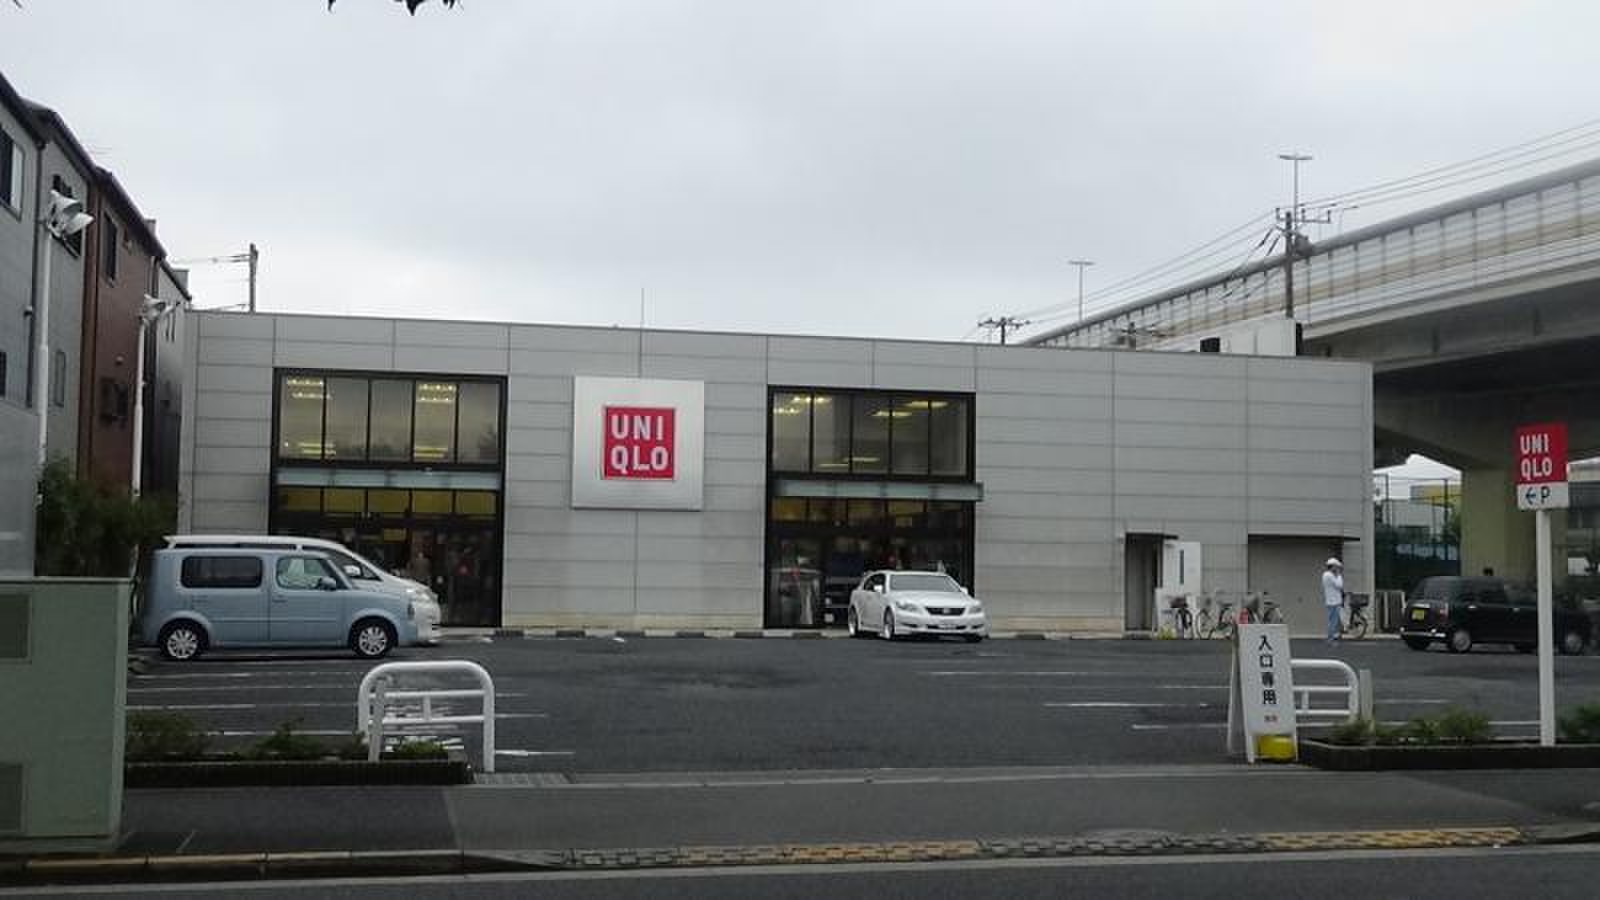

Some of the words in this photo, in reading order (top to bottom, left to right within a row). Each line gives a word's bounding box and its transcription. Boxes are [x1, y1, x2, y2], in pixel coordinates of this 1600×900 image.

[611, 415, 663, 440] UNI
[1520, 433, 1549, 454] UNI
[611, 445, 668, 474] QLO
[1521, 457, 1552, 480] QLO
[1541, 486, 1550, 504] P
[1258, 635, 1277, 705] 入口専用
